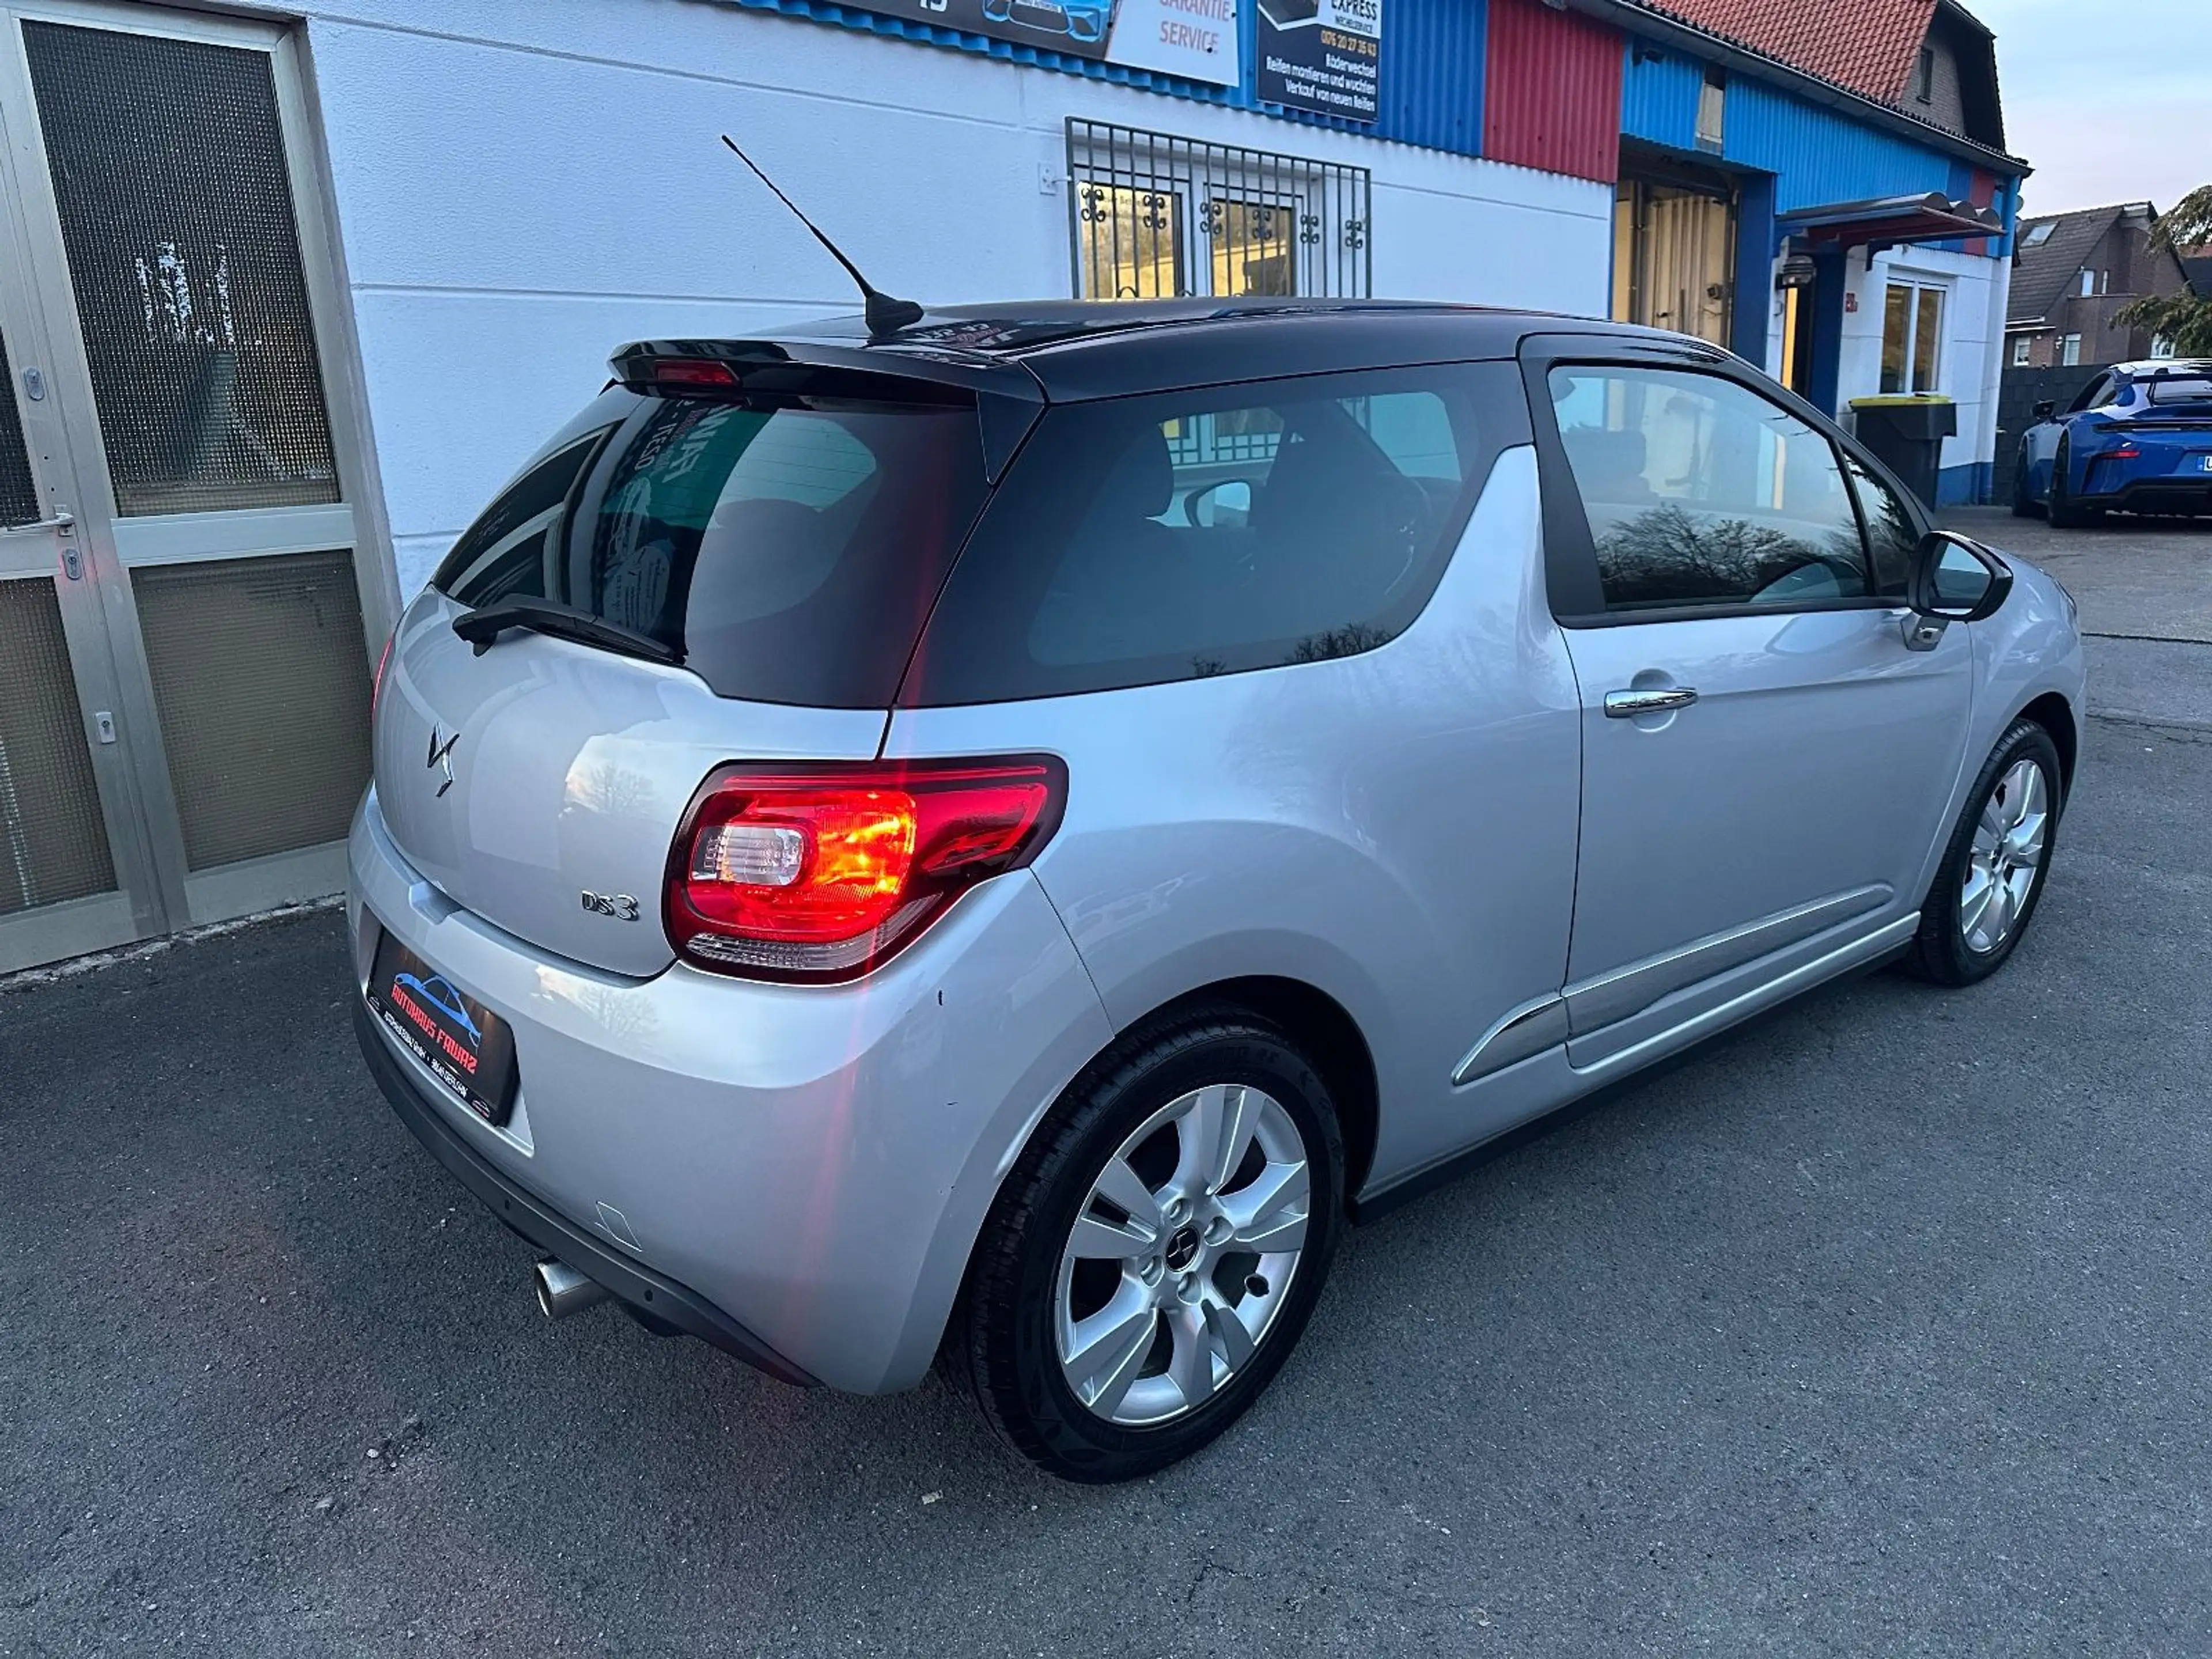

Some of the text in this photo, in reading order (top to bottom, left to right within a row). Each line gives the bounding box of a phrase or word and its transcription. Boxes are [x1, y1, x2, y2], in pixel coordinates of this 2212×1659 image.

[1159, 0, 1231, 22] RANTIE
[1160, 20, 1219, 54] SERVICE
[1266, 55, 1291, 75] Reifen
[1291, 65, 1330, 85] montieren
[1330, 74, 1344, 88] und
[1285, 78, 1316, 99] Verkauf
[1316, 88, 1330, 102] von
[1330, 92, 1353, 107] neuen
[581, 889, 640, 922] DS3
[391, 983, 437, 1039] AUTOHAUS
[435, 1028, 479, 1075] FAWAZ
